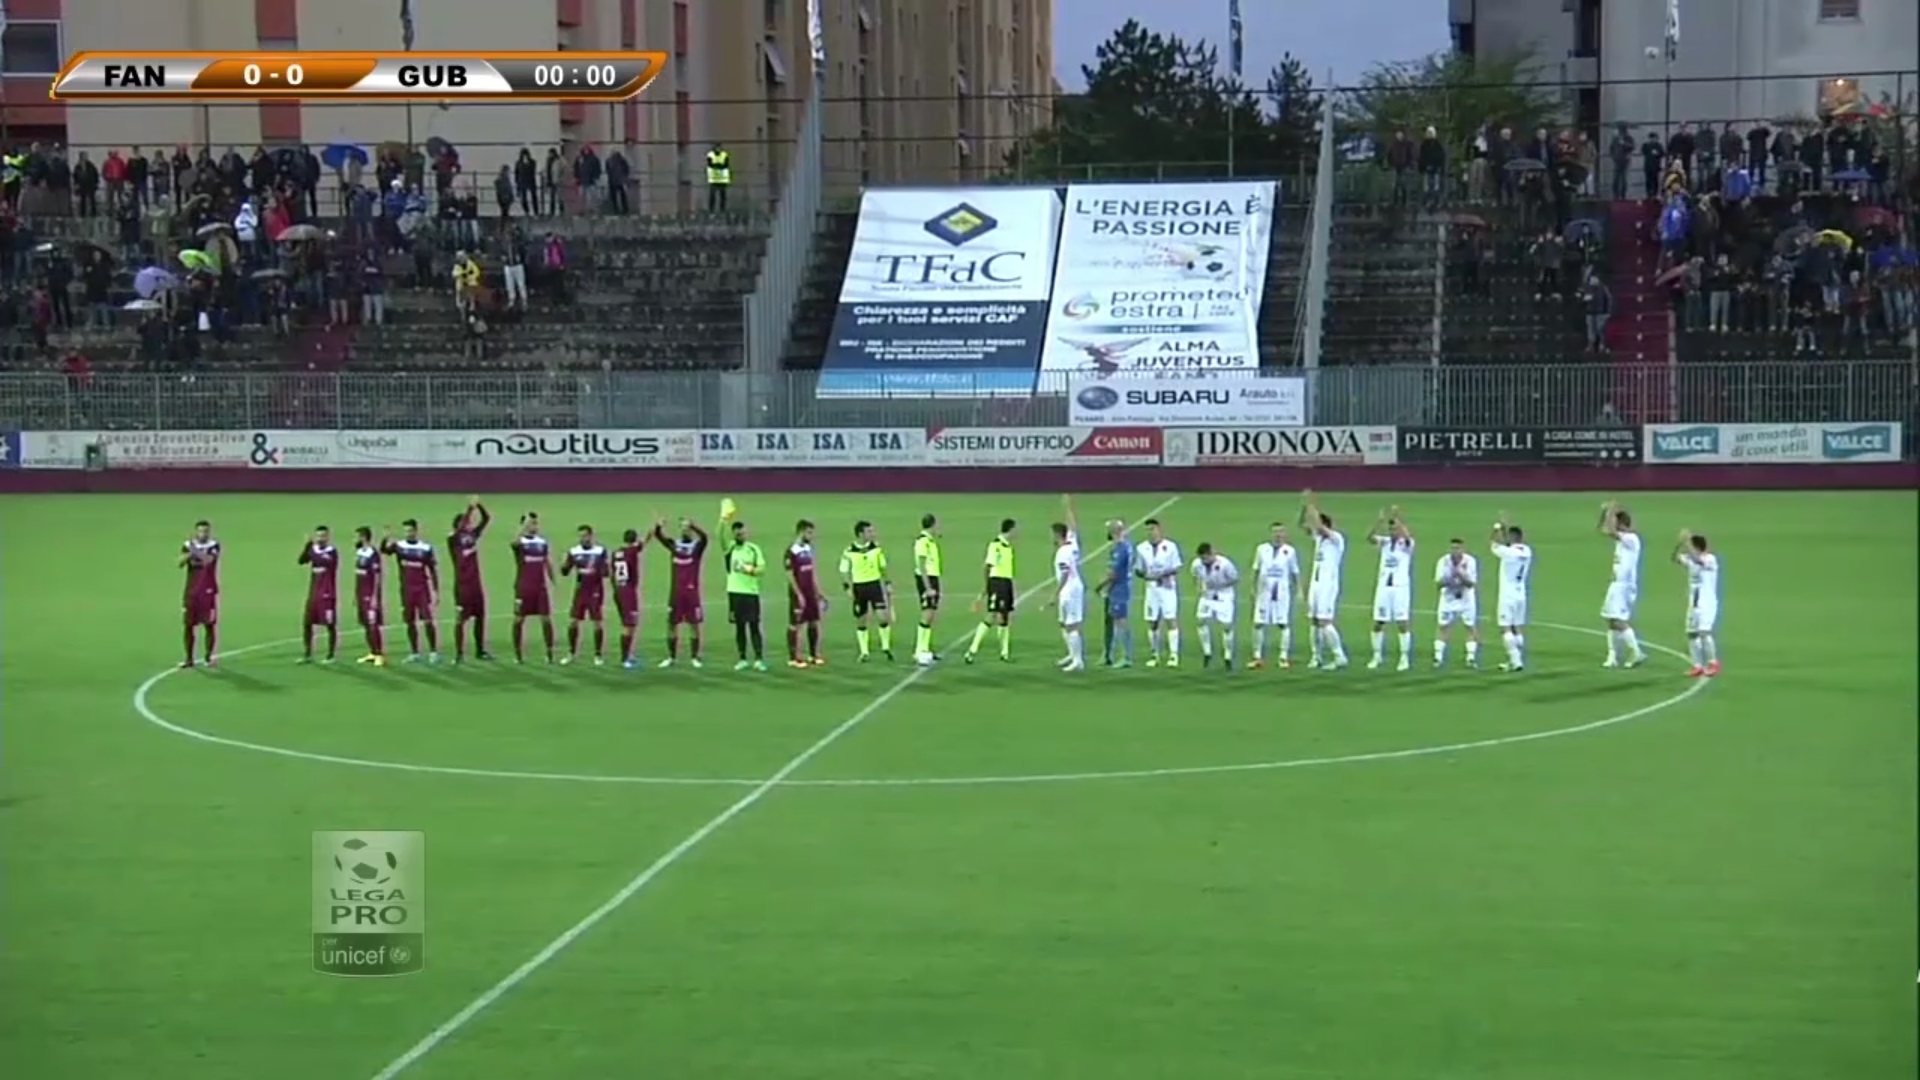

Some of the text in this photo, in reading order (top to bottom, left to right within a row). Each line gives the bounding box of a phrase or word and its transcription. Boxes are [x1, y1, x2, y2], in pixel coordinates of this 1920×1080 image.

[1076, 199, 1233, 216] L'ENERGIA
[1092, 219, 1241, 236] PASSIONE
[876, 251, 1026, 284] TFdC
[1111, 288, 1249, 306] prometeo
[854, 304, 1027, 317] Chiarezza e semplicità
[1111, 302, 1184, 319] estra
[857, 314, 1018, 325] per i tuoi servizi CAF
[1121, 325, 1182, 334] sostiene
[1158, 340, 1221, 352] ALMA
[1132, 355, 1245, 368] JUVENTUS
[1126, 389, 1230, 405] SUBARU
[251, 432, 279, 465] &
[476, 432, 660, 456] nautilus
[701, 433, 734, 451] ISA
[757, 433, 790, 451] ISA
[813, 433, 846, 451] ISA
[869, 433, 902, 451] ISA
[934, 435, 1074, 451] SISTEMI D'UFFICIO
[1093, 435, 1150, 450] Canon
[1197, 430, 1363, 455] IDRONOVA
[1404, 431, 1533, 450] PIETRELLI
[1656, 435, 1713, 451] VALCE
[1826, 434, 1883, 450] VALCE
